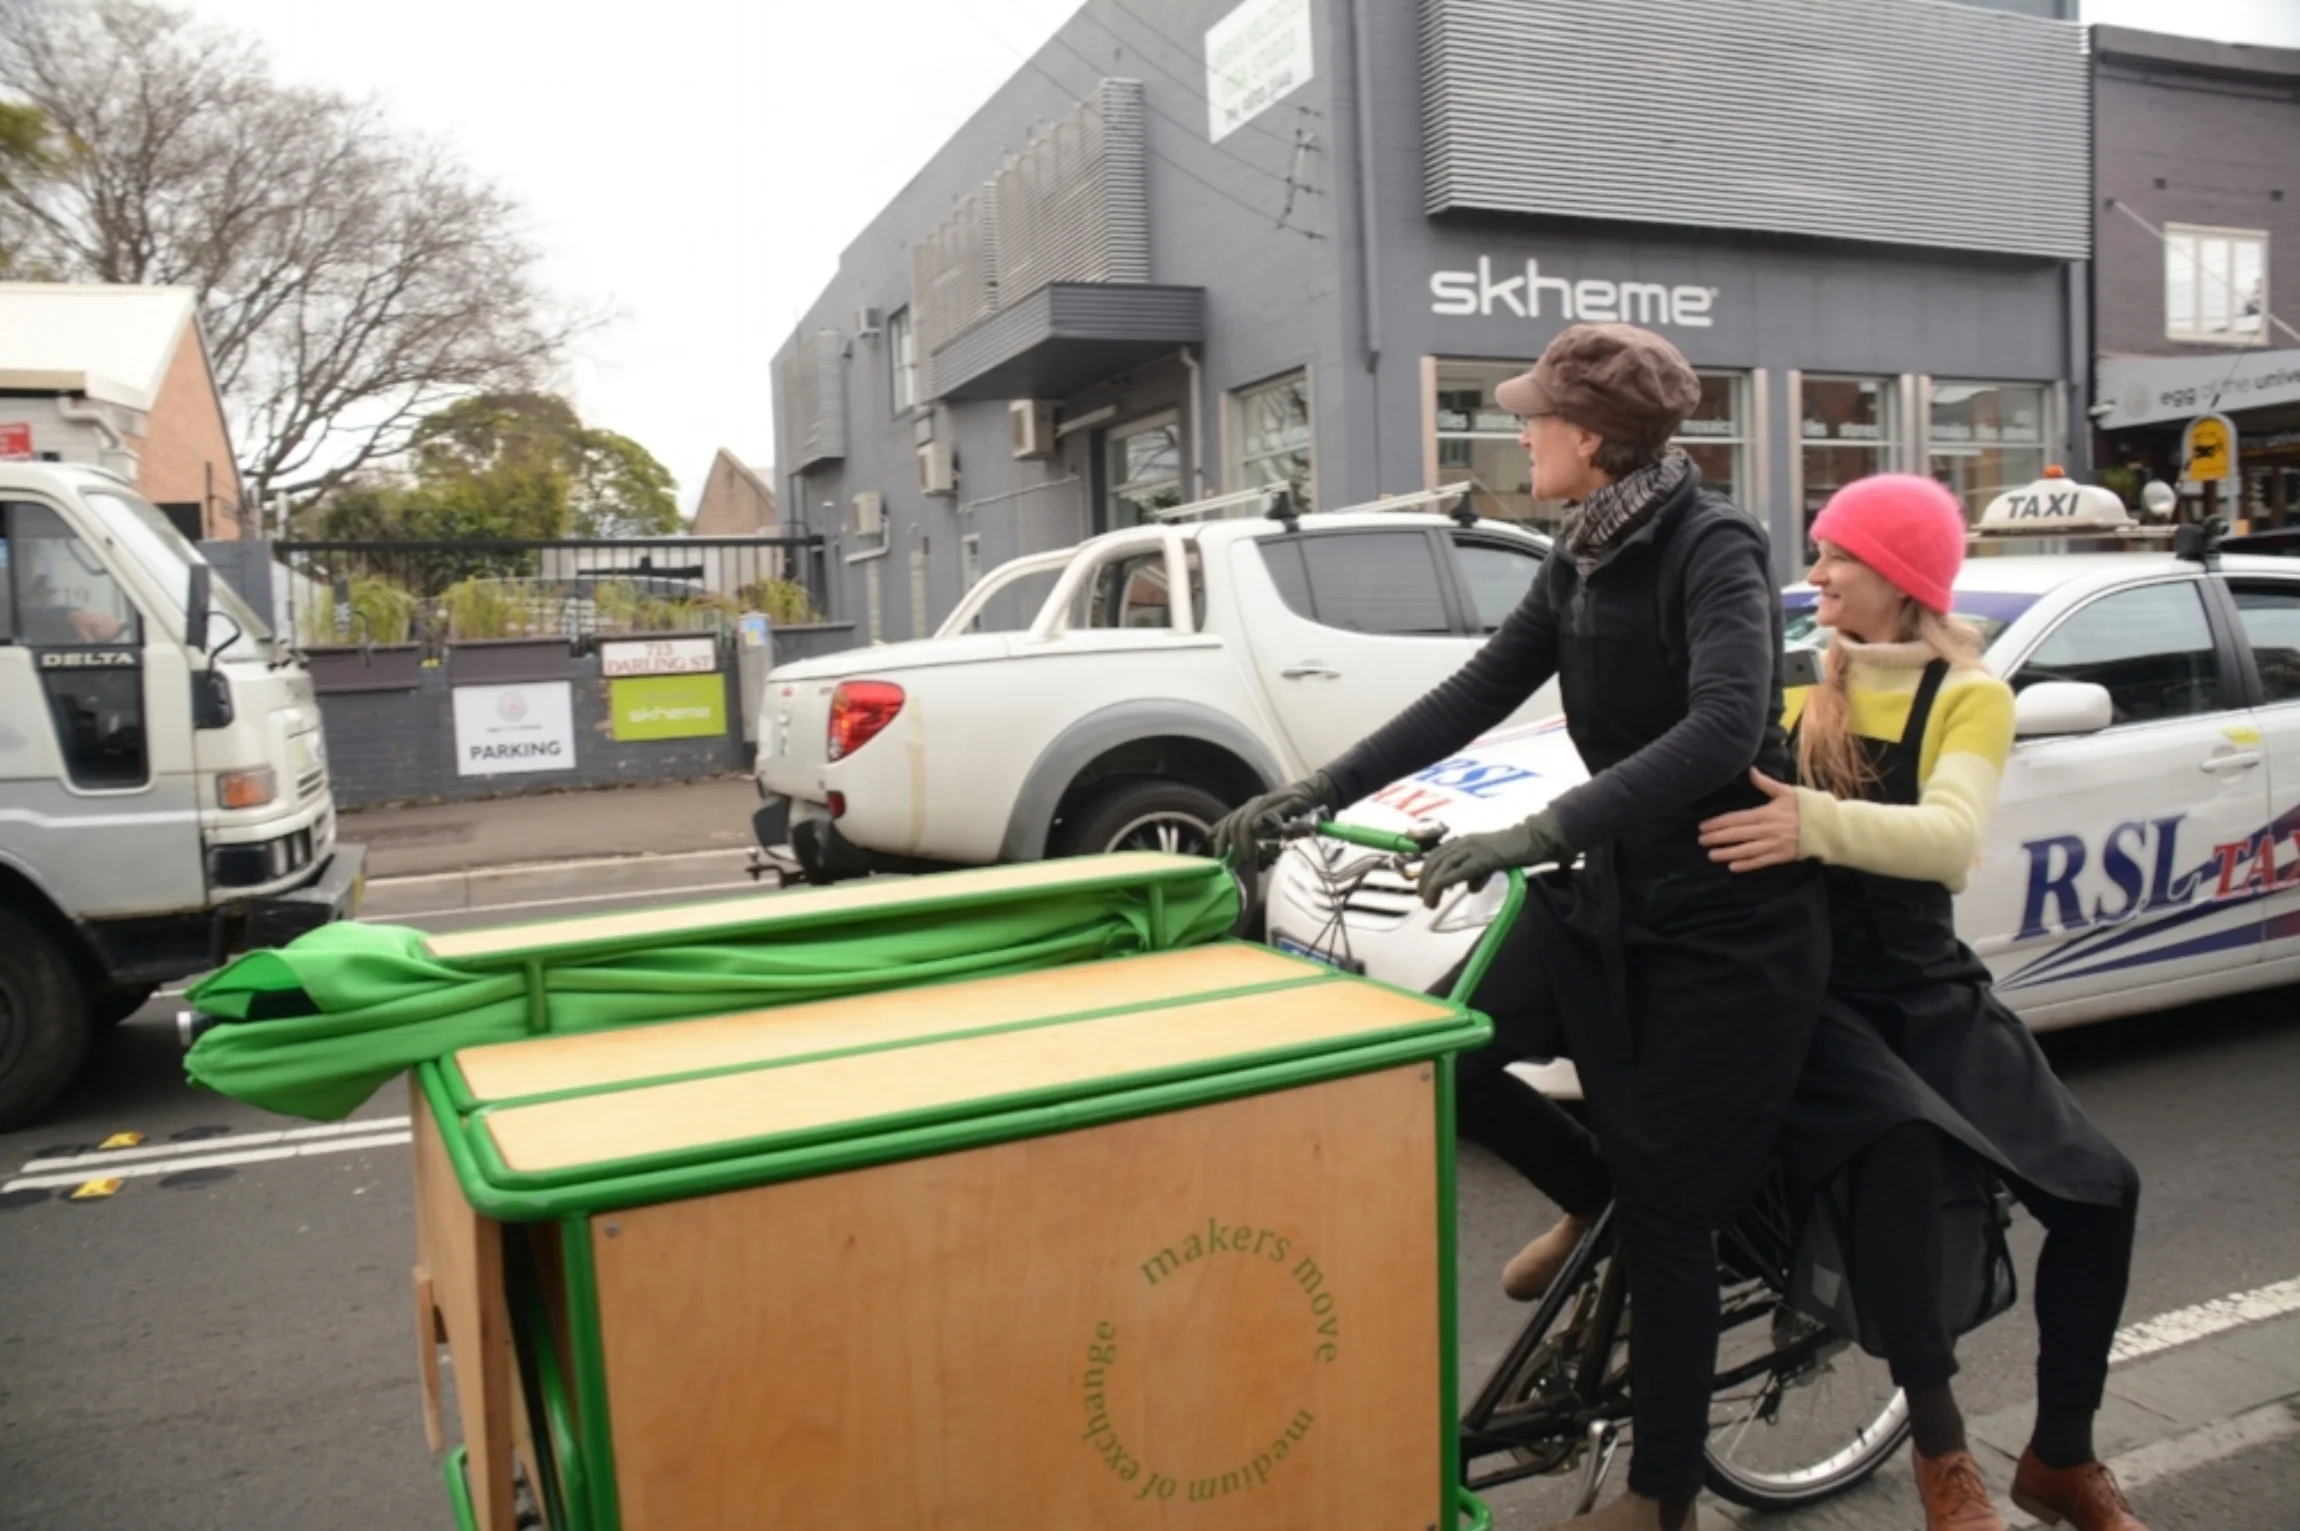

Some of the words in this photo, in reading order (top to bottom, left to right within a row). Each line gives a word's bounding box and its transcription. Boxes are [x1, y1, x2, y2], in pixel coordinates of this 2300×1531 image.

[1430, 255, 1714, 327] skheme
[2160, 388, 2195, 407] egg
[2008, 492, 2079, 519] TAXI
[42, 652, 134, 667] DELTA
[645, 642, 673, 656] 713
[608, 656, 686, 673] DARLING
[690, 656, 711, 670] ST
[470, 739, 561, 760] PARKING
[1415, 758, 1541, 799] RSL
[2014, 811, 2202, 941] RSL
[1140, 1217, 1292, 1286] makers
[1291, 1256, 1338, 1363] move
[1082, 1321, 1140, 1482] exchange
[1189, 1409, 1315, 1501] medium
[1134, 1472, 1177, 1500] of
